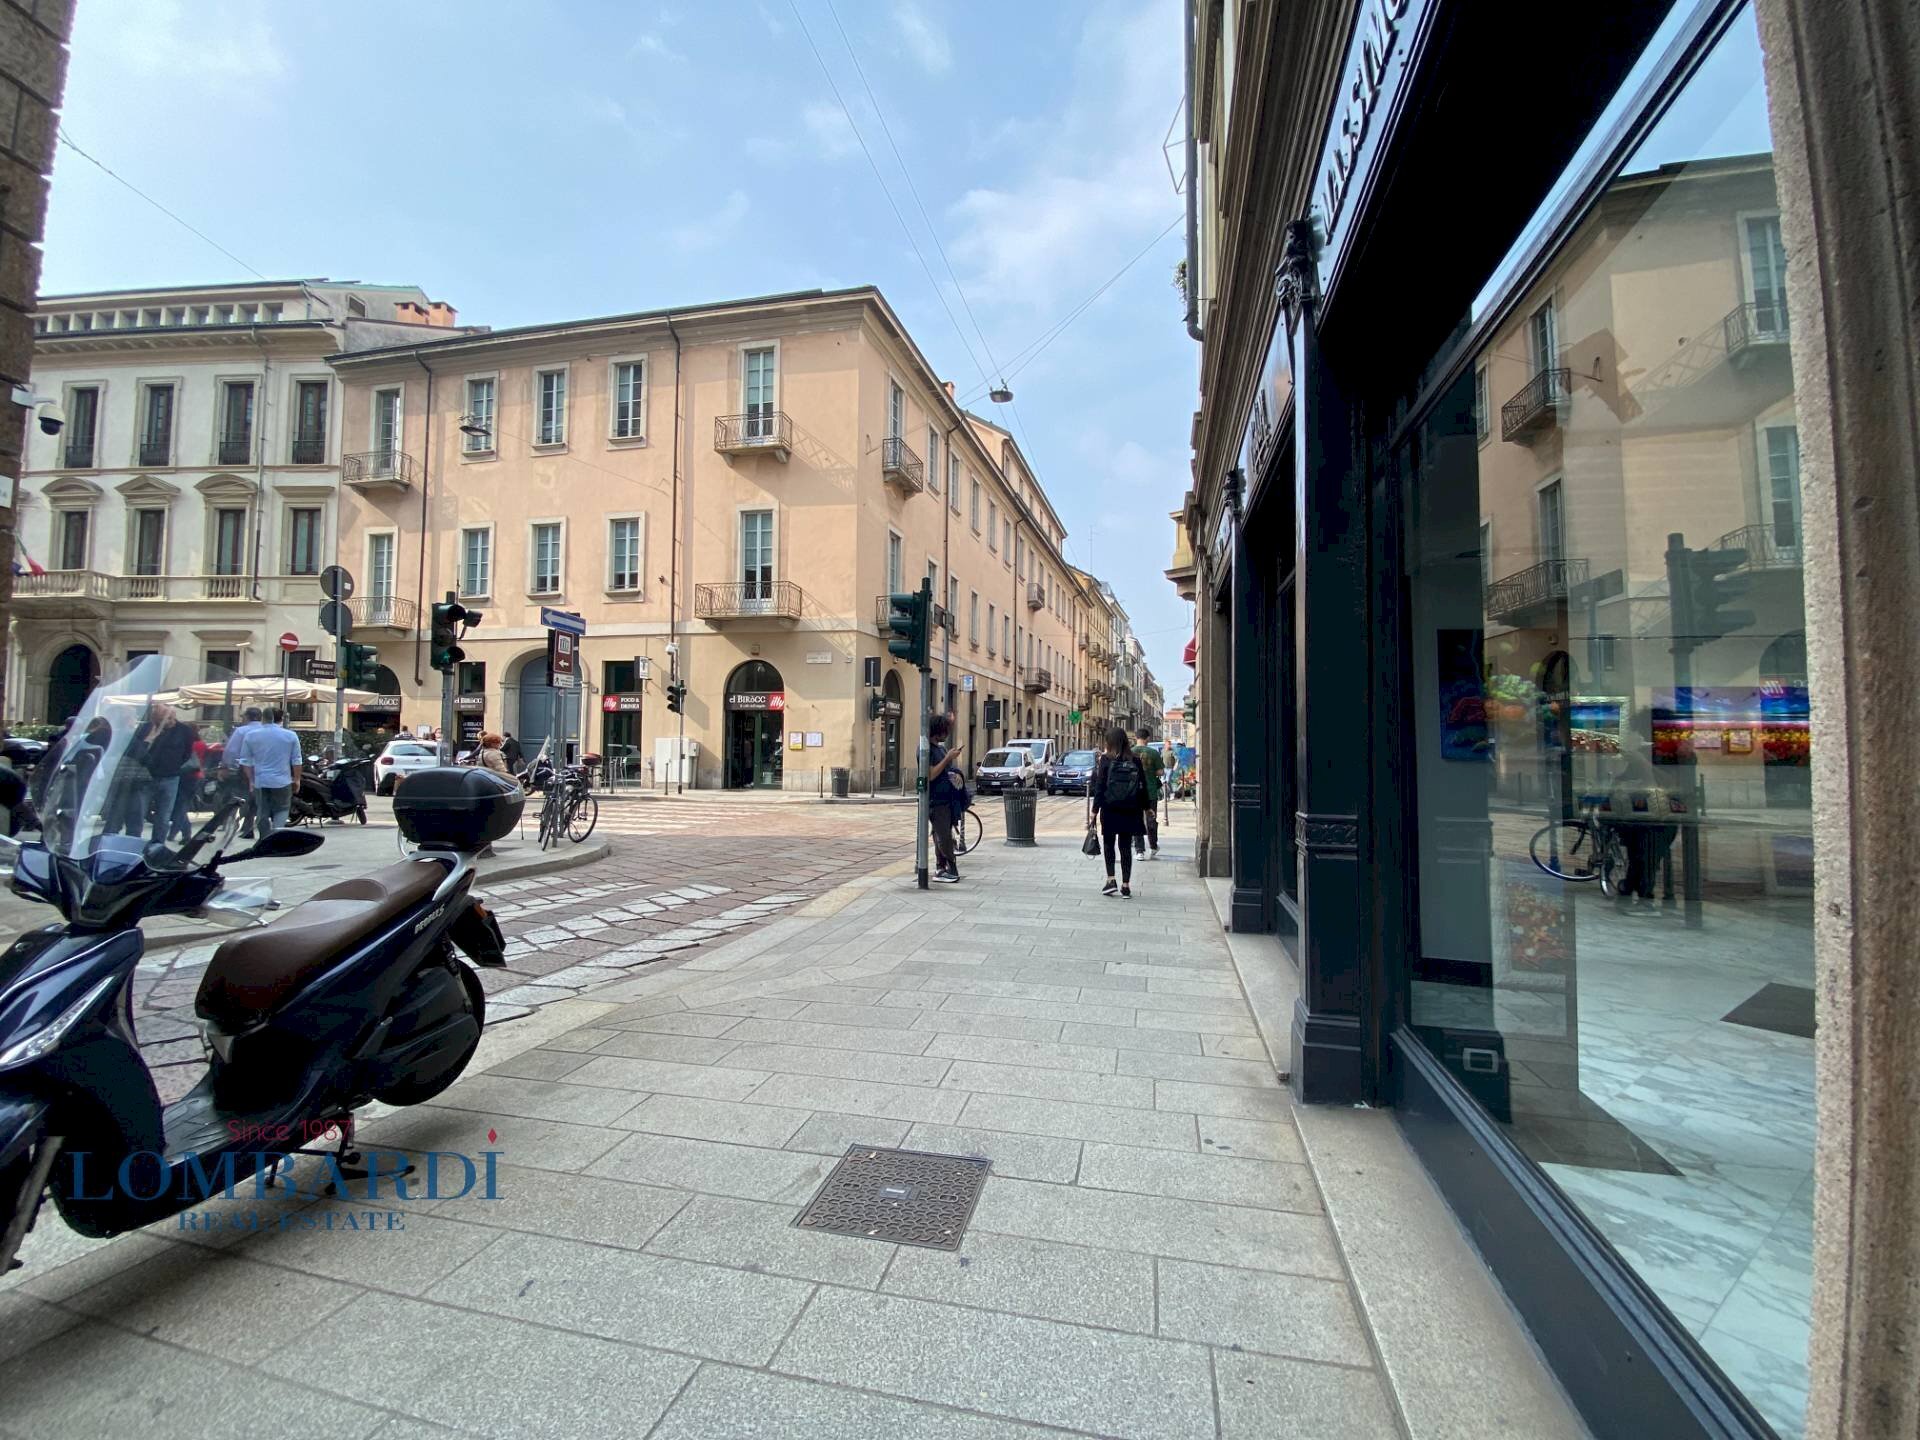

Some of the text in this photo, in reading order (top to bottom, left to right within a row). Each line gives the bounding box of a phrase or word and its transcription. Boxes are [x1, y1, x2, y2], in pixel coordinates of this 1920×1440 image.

[604, 697, 617, 711] illy
[729, 695, 735, 703] el
[770, 696, 784, 709] illy
